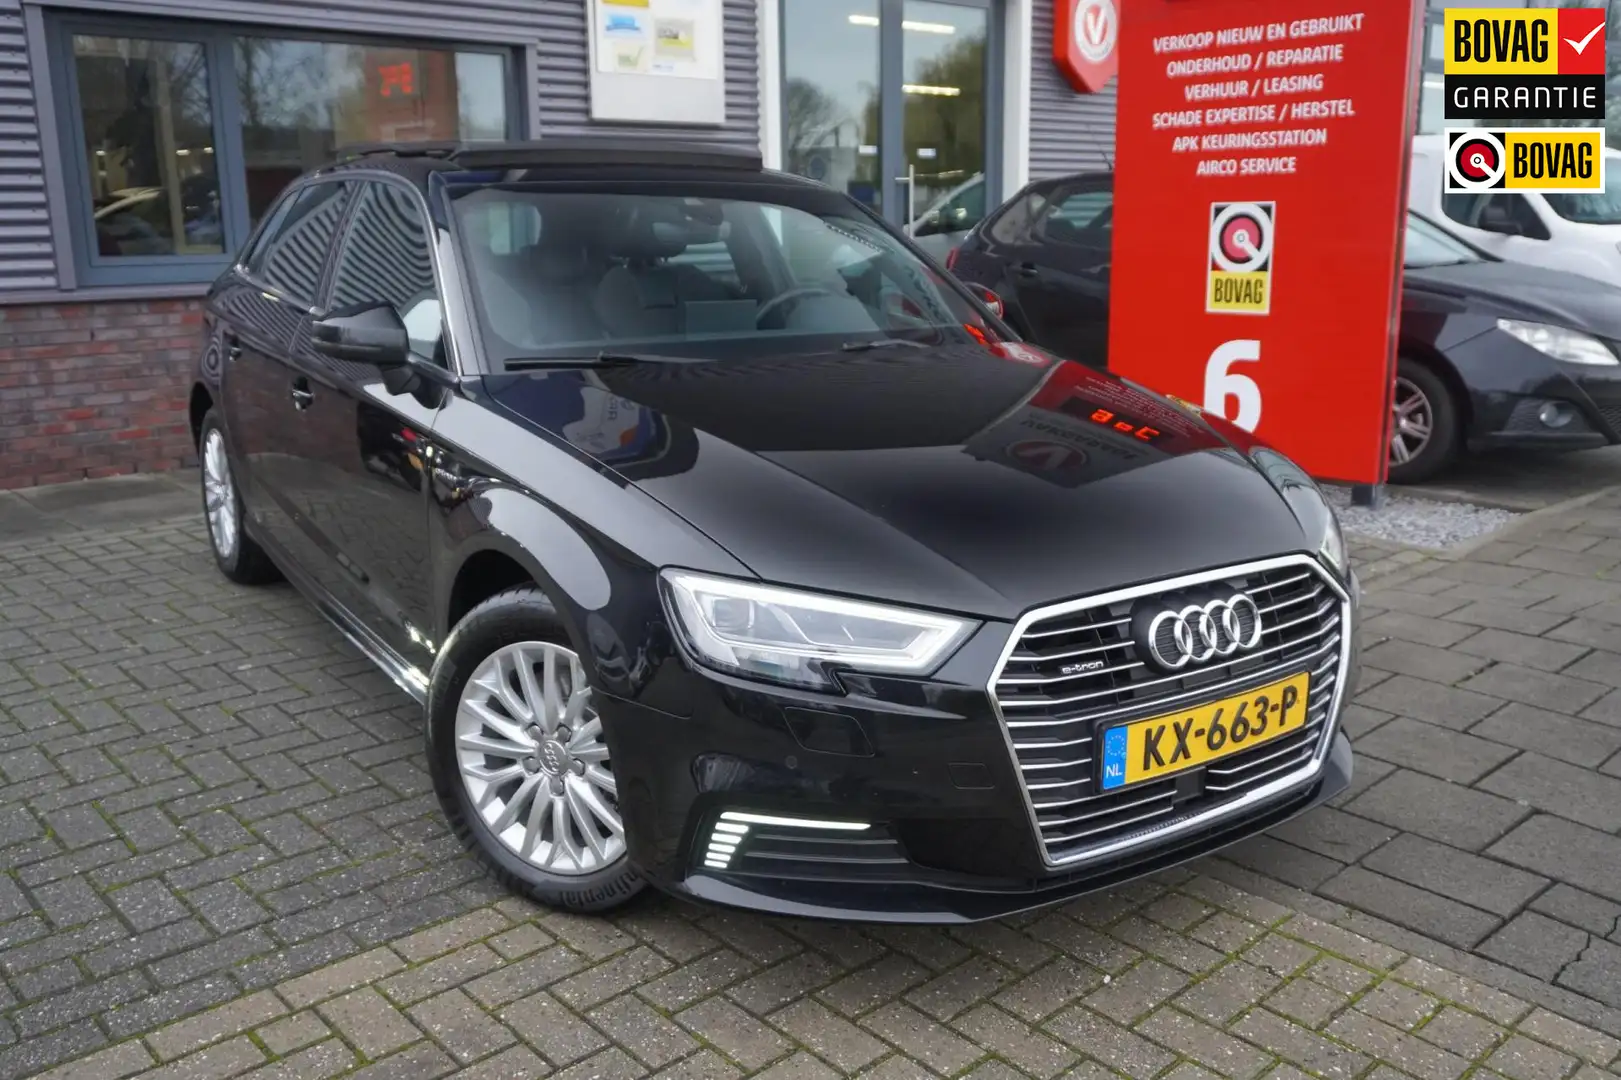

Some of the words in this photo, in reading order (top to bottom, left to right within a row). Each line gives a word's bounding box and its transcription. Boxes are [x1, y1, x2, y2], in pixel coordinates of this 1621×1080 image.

[1153, 31, 1213, 53] VERKOOP
[1216, 25, 1264, 46] NIEUW
[1266, 22, 1286, 40] EN
[1289, 13, 1364, 38] GEBRUIKT
[1166, 53, 1251, 77] ONDERHOUD
[1253, 52, 1263, 71] /
[1266, 44, 1344, 67] REPARATIE
[1184, 80, 1249, 101] VERHUUR
[1250, 79, 1260, 97] /
[1263, 74, 1324, 94] LEASING
[1152, 110, 1202, 129] SCHADE
[1205, 104, 1276, 125] EXPERTISE
[1278, 103, 1288, 122] /
[1291, 99, 1355, 120] HERSTEL
[1172, 136, 1198, 152] APK
[1201, 128, 1327, 150] KEURINGSSTATION
[1196, 159, 1237, 176] AIRCO
[1239, 156, 1296, 175] SERVICE
[1214, 278, 1263, 304] BOVAG
[1203, 339, 1262, 433] 6
[1062, 660, 1104, 674] e-tron
[1143, 685, 1298, 771] KX-663-P
[1105, 763, 1122, 779] NL
[561, 871, 638, 907] ntinental
